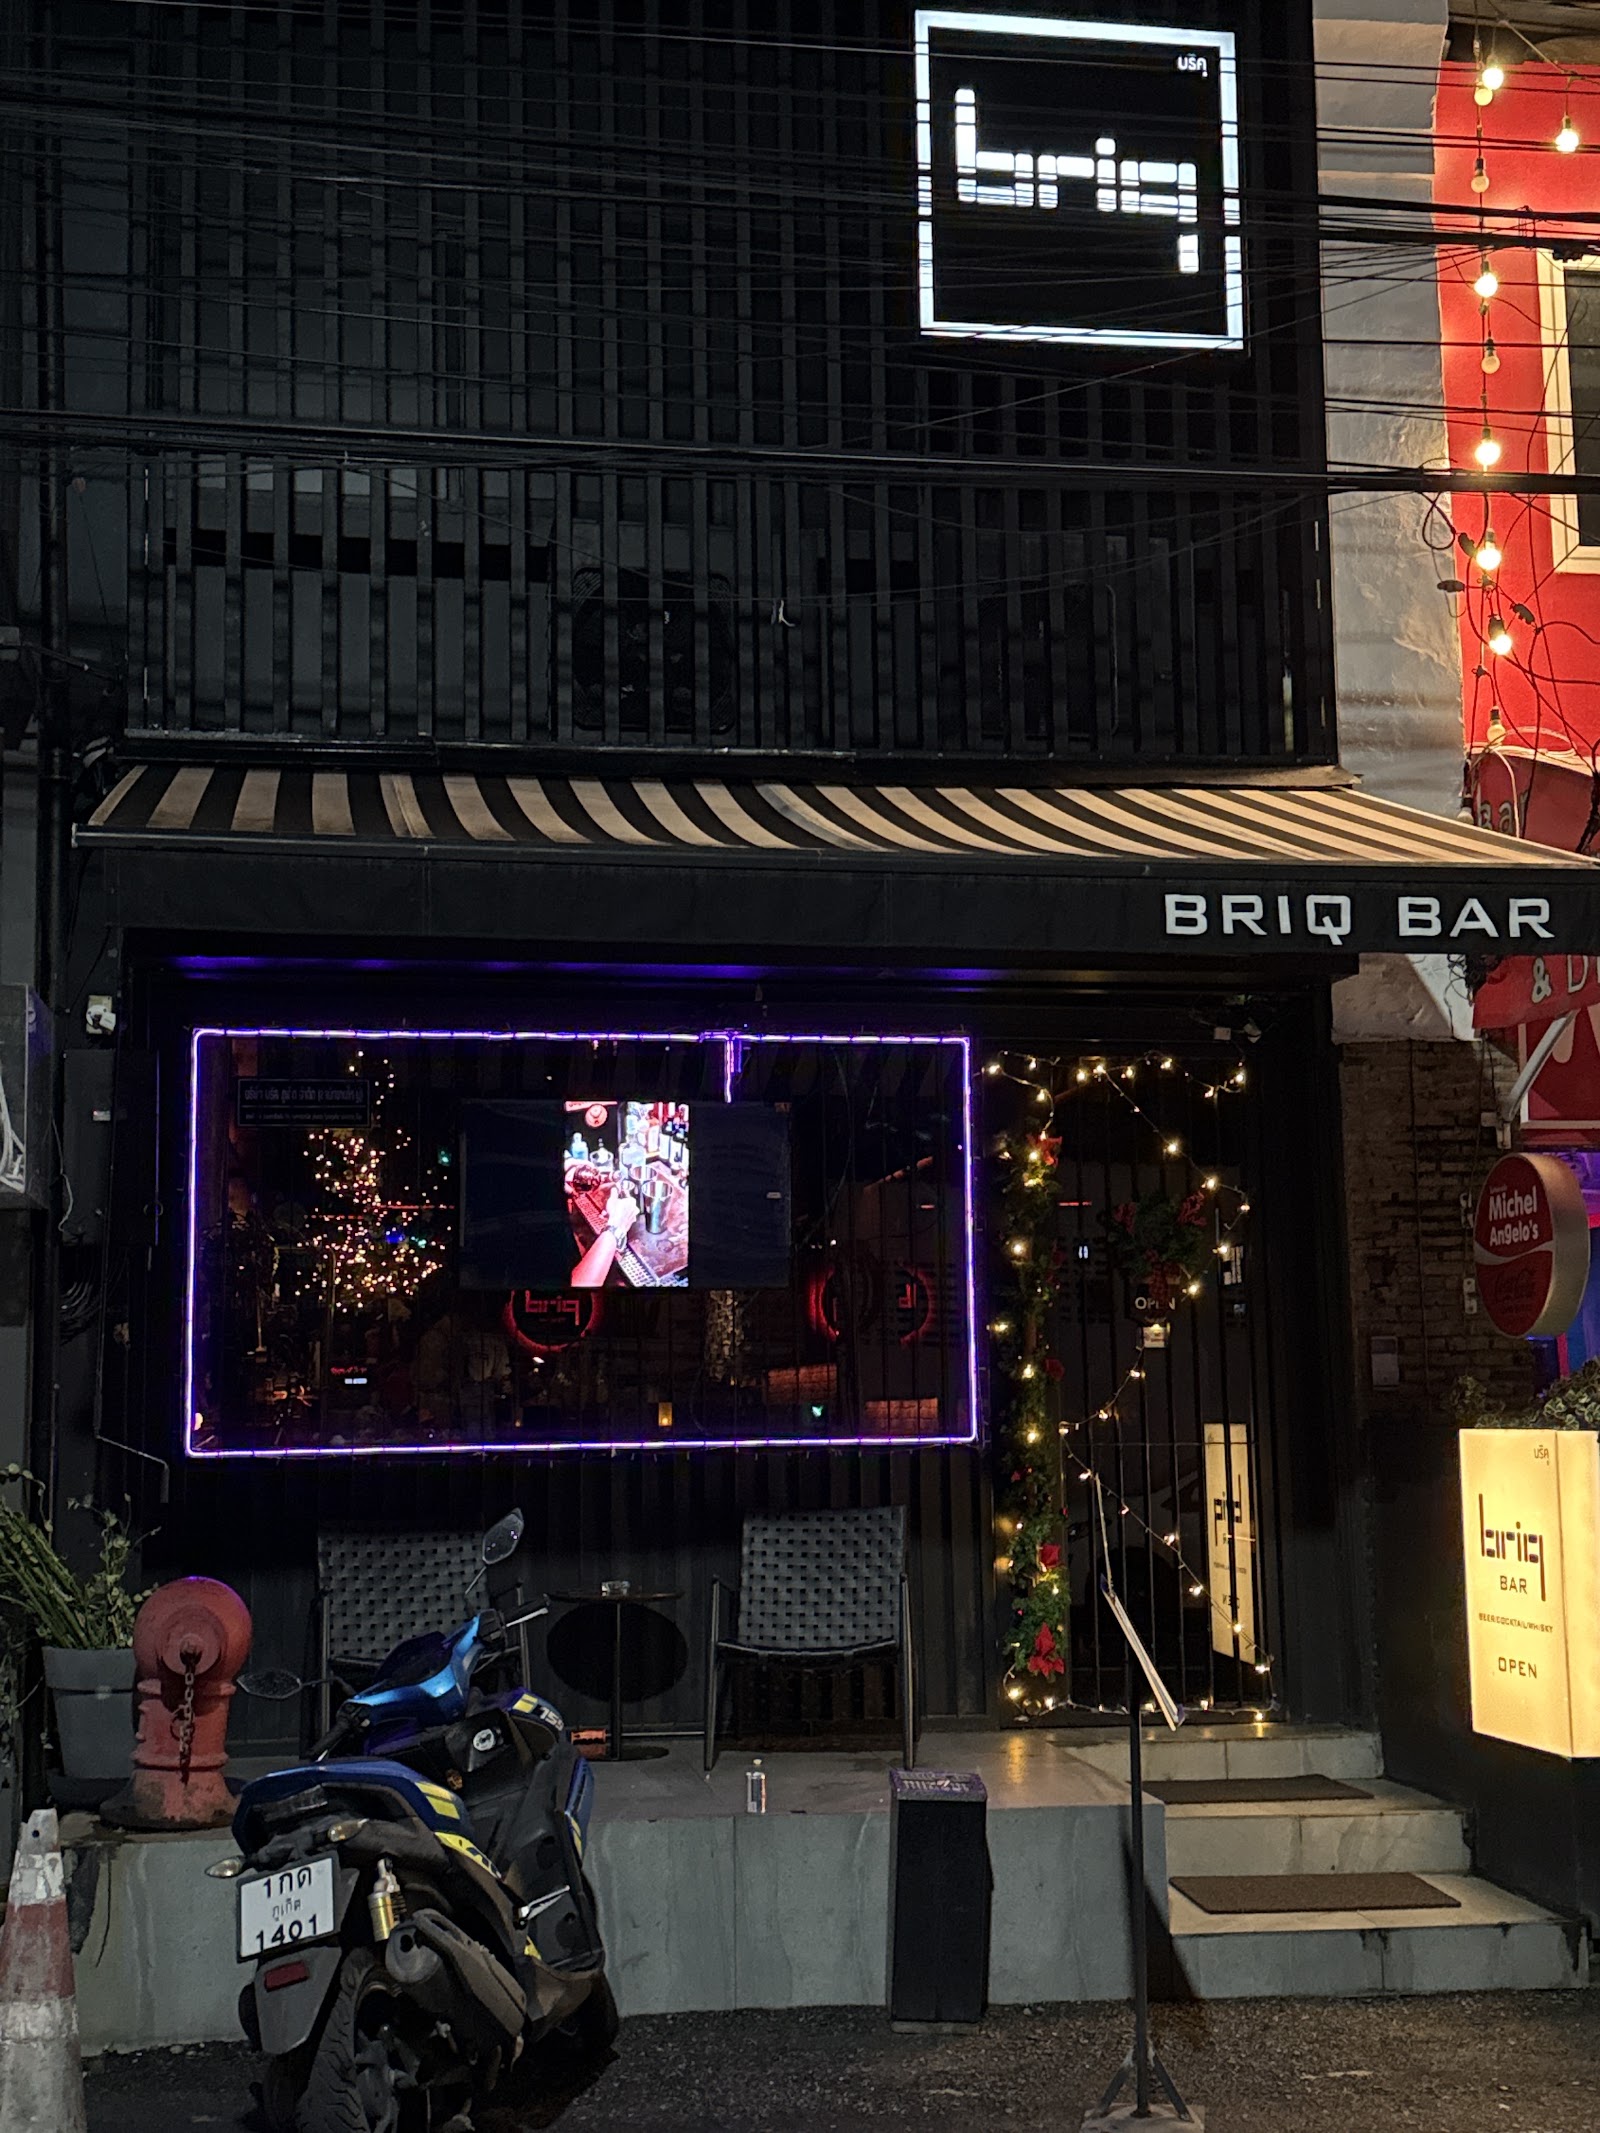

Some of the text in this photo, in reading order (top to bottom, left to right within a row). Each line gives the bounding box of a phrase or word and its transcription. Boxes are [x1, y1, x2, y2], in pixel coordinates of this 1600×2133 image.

[955, 87, 1200, 275] briq
[1164, 893, 1555, 945] BRIQ BAR
[1531, 956, 1552, 1004] &
[1488, 1185, 1538, 1222] Michel
[1488, 1219, 1539, 1247] Angelo's
[1478, 1493, 1546, 1602] briq
[1499, 1575, 1528, 1594] BAR
[1498, 1656, 1538, 1679] OPEN
[263, 1866, 313, 1899] 1กด
[271, 1897, 302, 1922] ภูเก็ต
[256, 1913, 318, 1953] 1401
